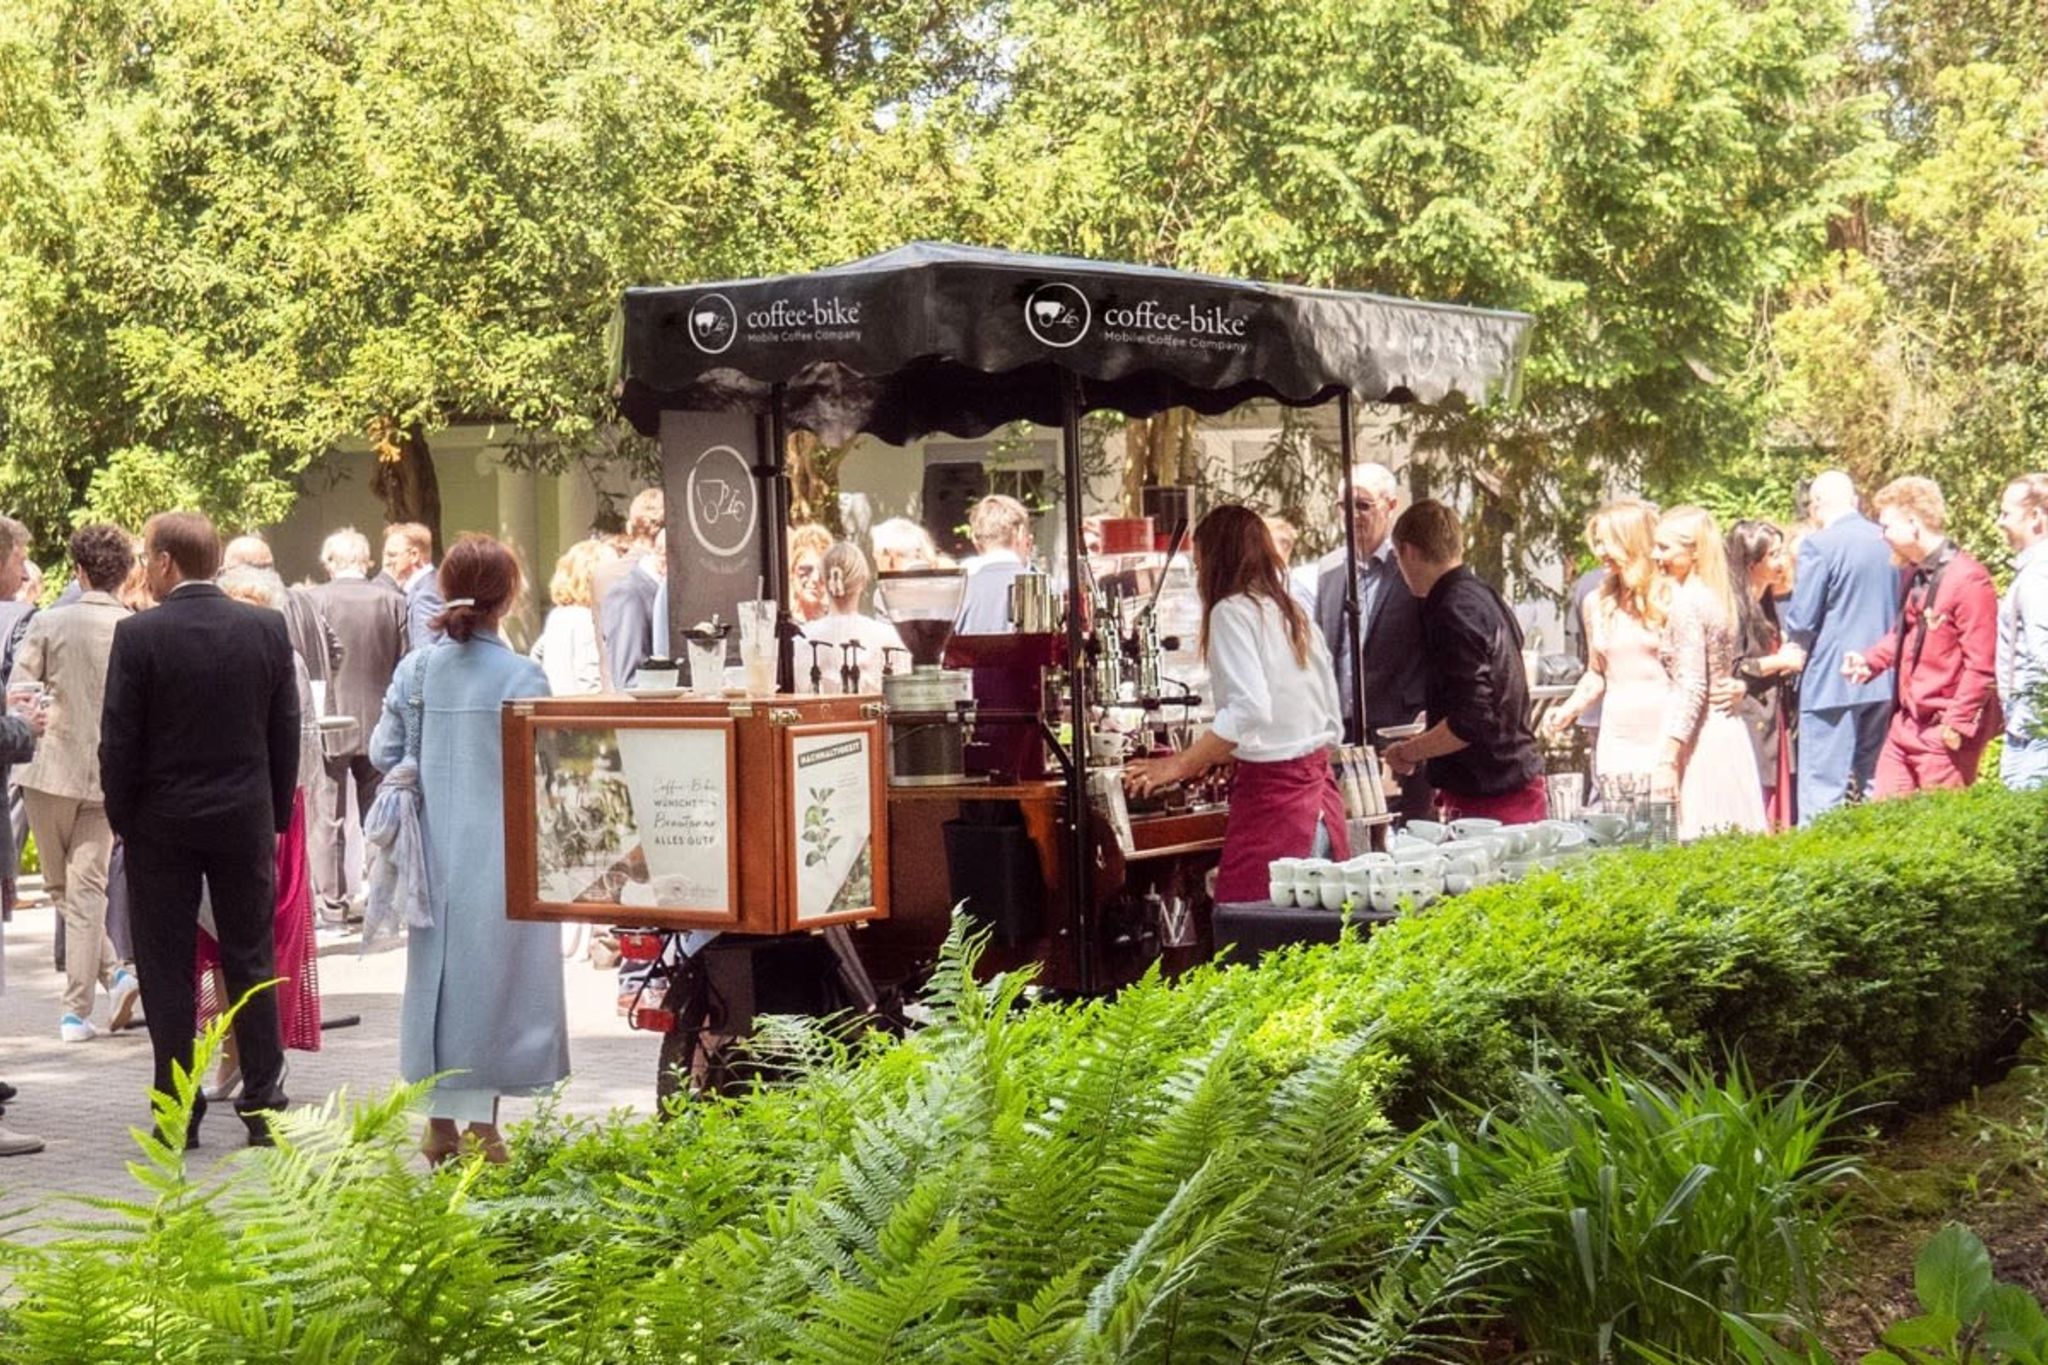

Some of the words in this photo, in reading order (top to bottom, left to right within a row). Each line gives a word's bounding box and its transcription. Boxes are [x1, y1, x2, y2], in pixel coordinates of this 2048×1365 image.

[747, 296, 860, 328] coffee-bike
[1104, 301, 1247, 336] coffee-bike
[748, 332, 779, 342] Mobile
[781, 331, 812, 342] Coffee
[815, 329, 861, 342] Company
[1104, 331, 1146, 343] Mobile
[1147, 334, 1186, 347] Coffee
[1189, 337, 1248, 353] Company
[655, 835, 684, 846] ALLES
